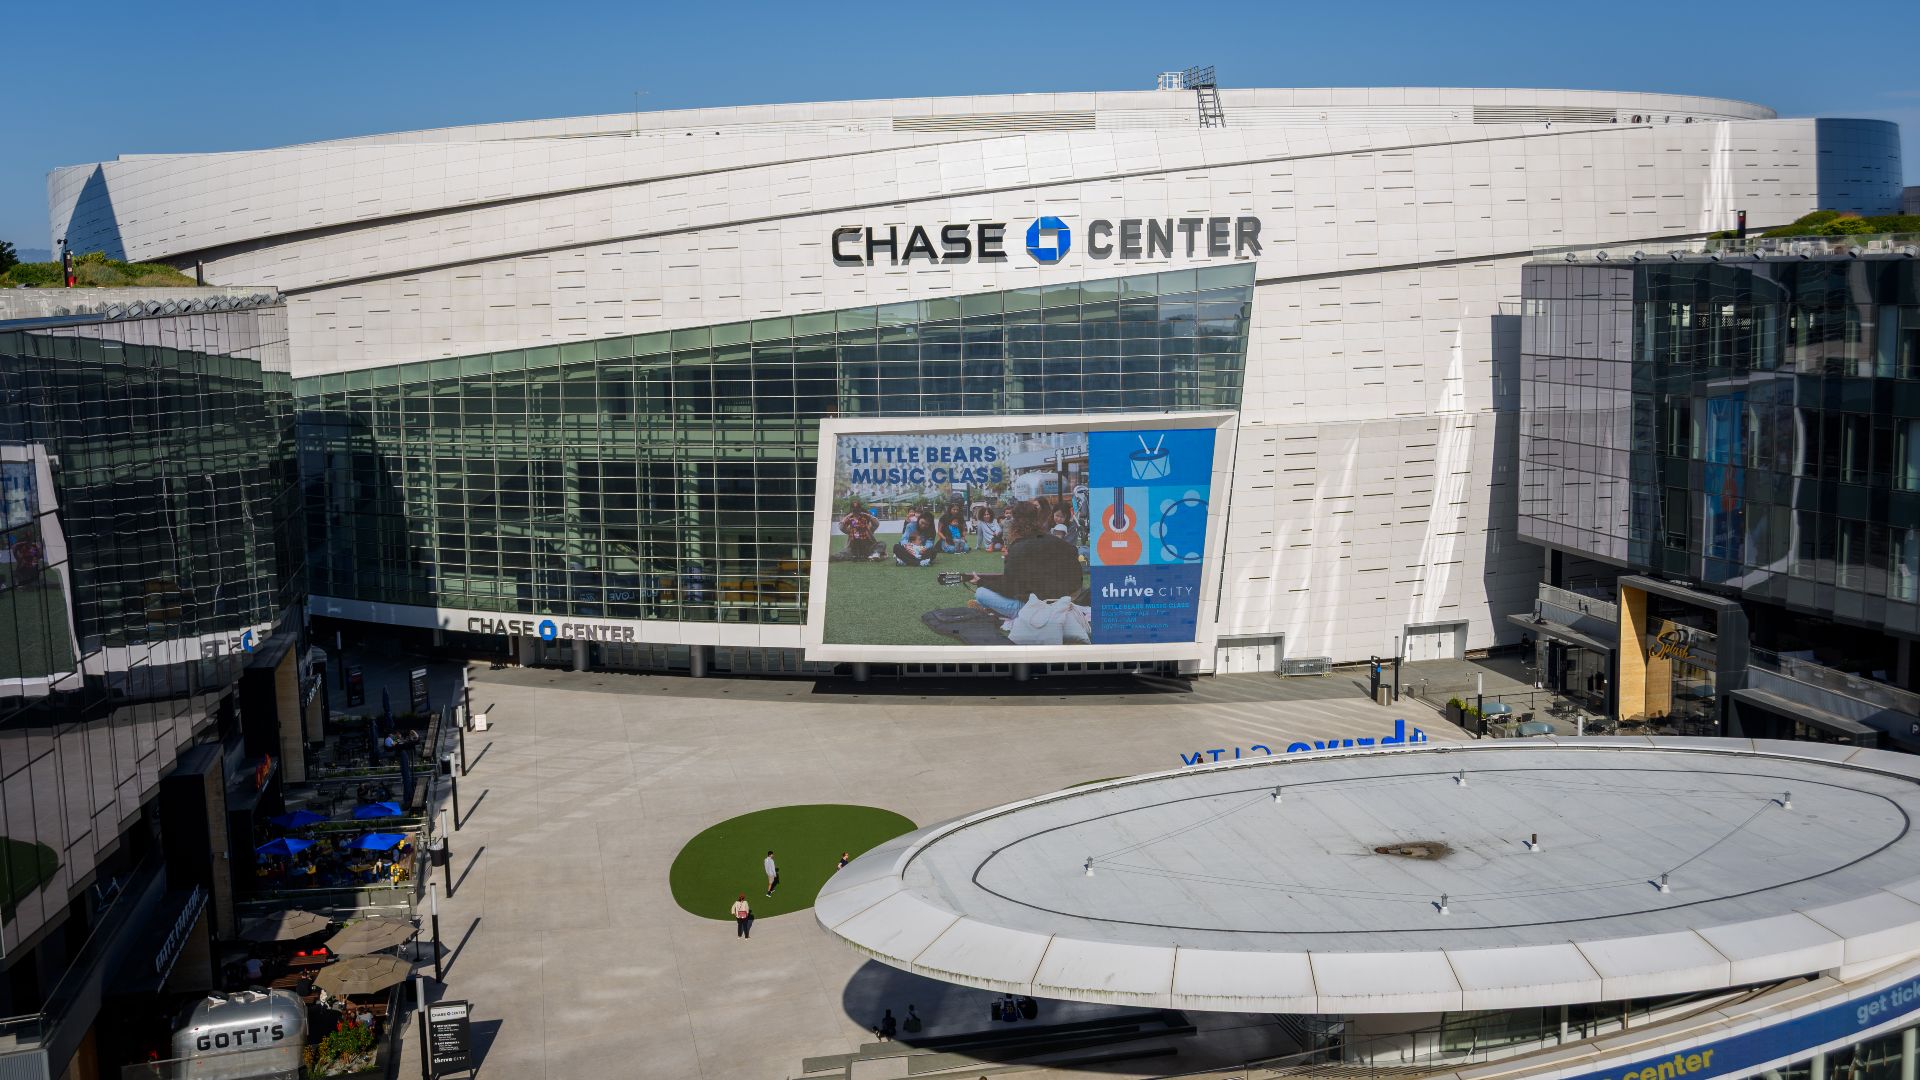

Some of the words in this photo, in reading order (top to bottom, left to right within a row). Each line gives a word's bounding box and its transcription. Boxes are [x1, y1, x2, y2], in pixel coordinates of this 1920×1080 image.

[831, 222, 1008, 263] CHASE
[1088, 216, 1263, 257] CENTER
[851, 447, 920, 464] LITTLE
[926, 446, 997, 463] BEARS
[851, 468, 926, 485] MUSIC
[931, 467, 1003, 485] CLASS
[1101, 582, 1154, 598] thrive
[1158, 586, 1193, 597] CITY
[468, 617, 535, 637] CHASE
[561, 623, 636, 643] CENTER
[1649, 631, 1697, 661] Splash
[1856, 994, 1888, 1025] get
[196, 1024, 285, 1052] GOTT'S
[1622, 1049, 1714, 1080] center
